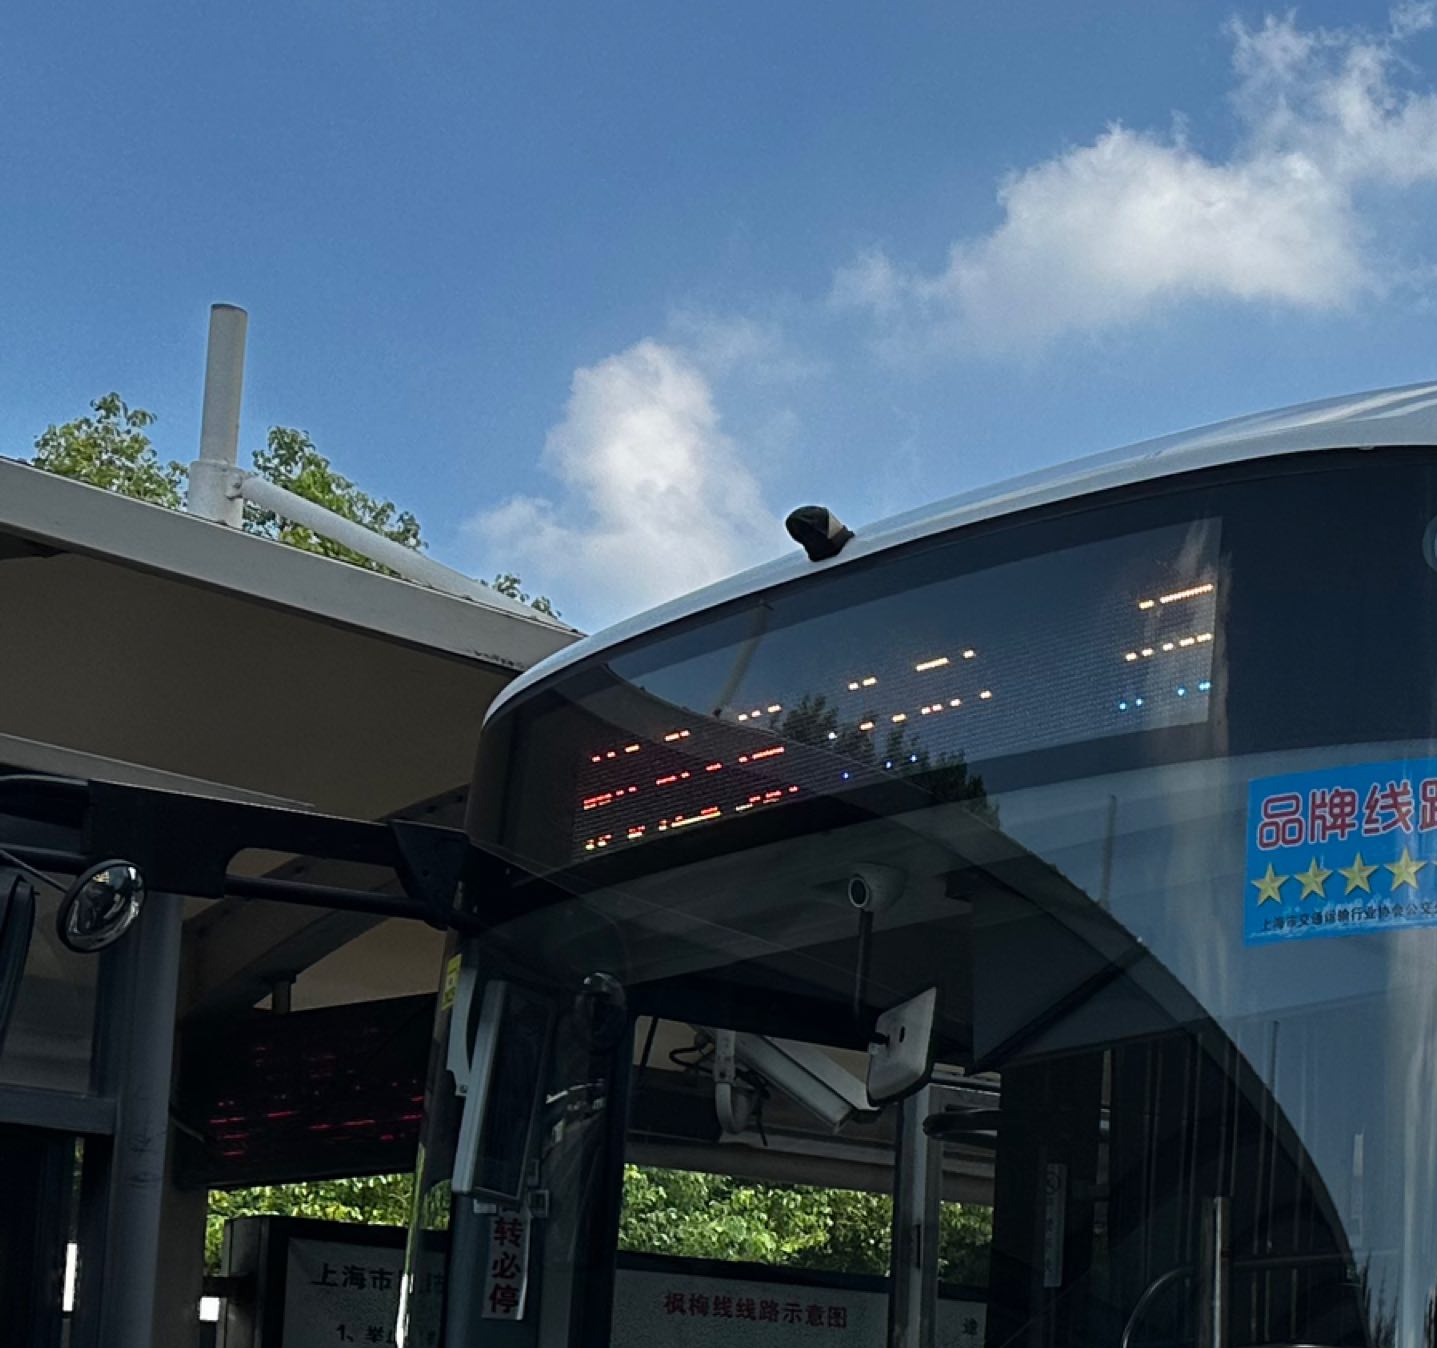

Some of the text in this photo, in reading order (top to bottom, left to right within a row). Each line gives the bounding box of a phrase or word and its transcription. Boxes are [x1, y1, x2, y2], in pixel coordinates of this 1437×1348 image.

[489, 1206, 523, 1313] 转必停
[664, 1292, 848, 1329] 枫梅线线路示意图
